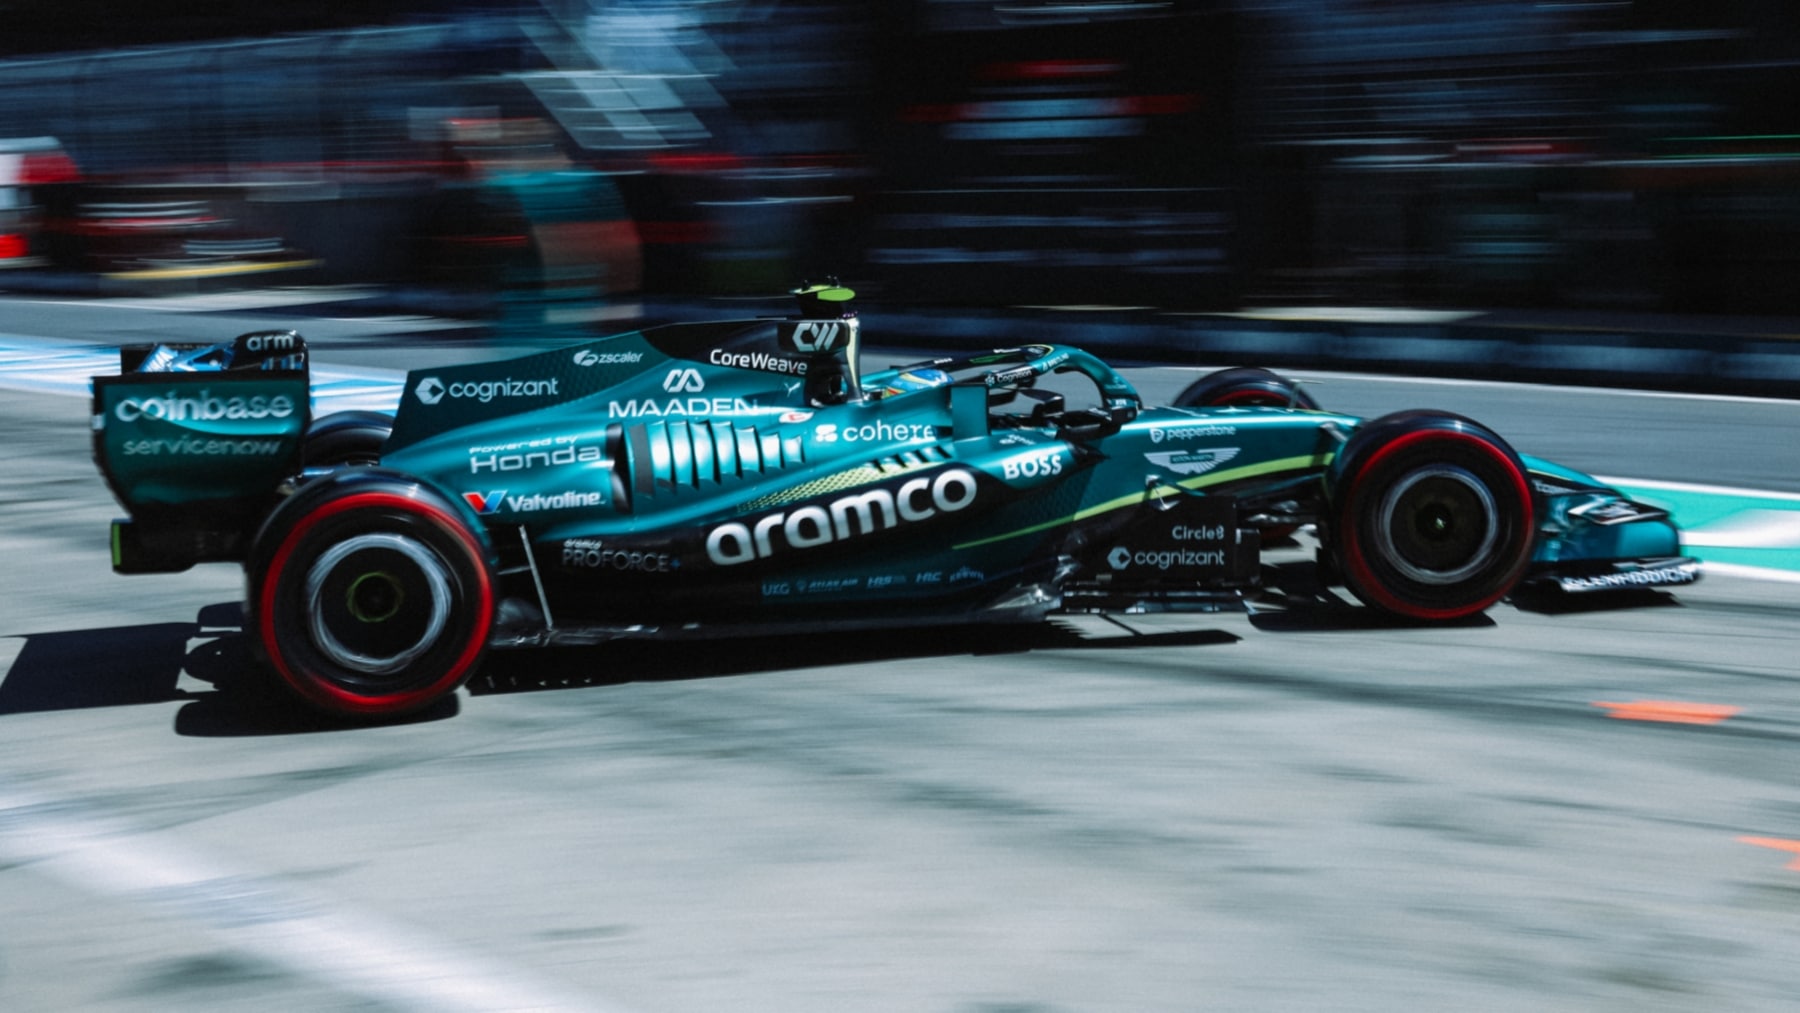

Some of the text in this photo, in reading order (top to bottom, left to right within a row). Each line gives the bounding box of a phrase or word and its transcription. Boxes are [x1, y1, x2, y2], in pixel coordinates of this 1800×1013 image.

[247, 334, 294, 350] arm
[598, 351, 643, 363] zscaler
[710, 349, 807, 375] CoreWeave
[449, 377, 559, 402] cognizant
[115, 389, 294, 421] coinbase
[609, 398, 758, 418] MAADEN
[1167, 425, 1236, 441] pepperstone
[123, 435, 282, 455] servicenow
[469, 437, 552, 454] Powered
[470, 446, 600, 474] Honda
[1002, 454, 1063, 479] BOSS
[506, 490, 602, 512] Valvoline
[705, 469, 977, 565] aramco
[1134, 549, 1224, 569] cognizant
